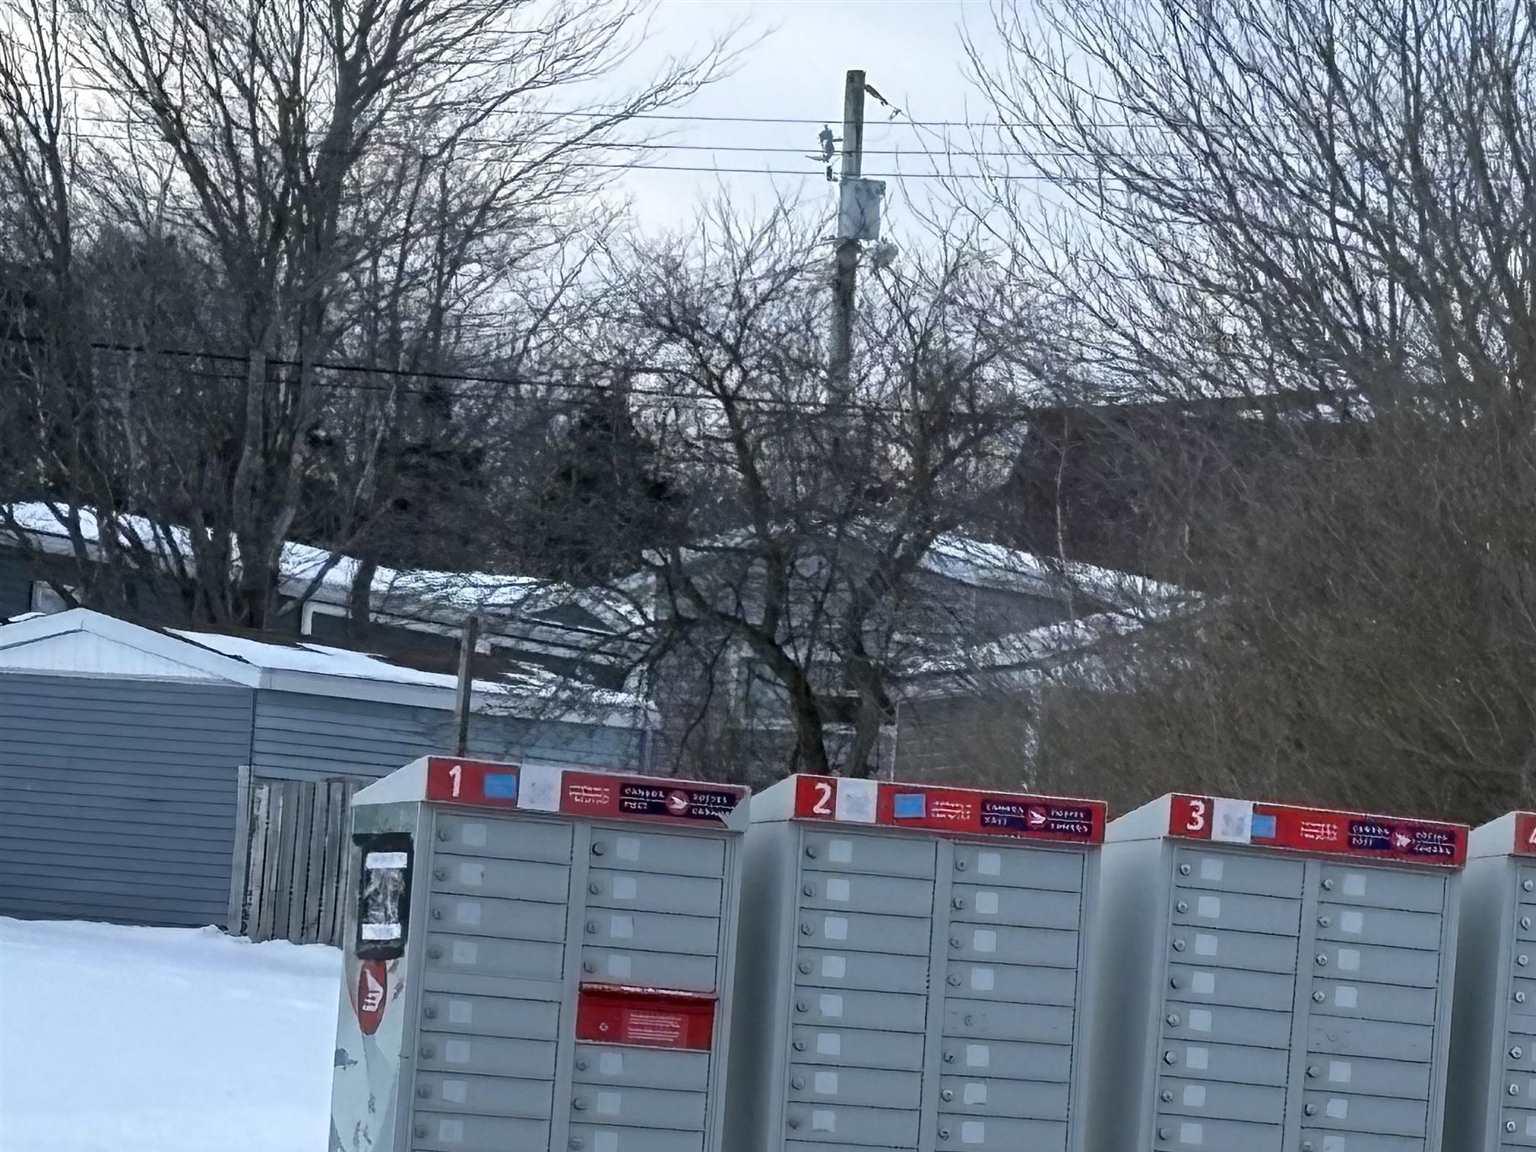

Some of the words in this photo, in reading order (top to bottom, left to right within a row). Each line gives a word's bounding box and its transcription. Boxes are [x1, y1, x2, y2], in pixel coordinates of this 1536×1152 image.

[449, 765, 462, 797] 1
[813, 783, 832, 815] 2
[1186, 800, 1205, 831] 3
